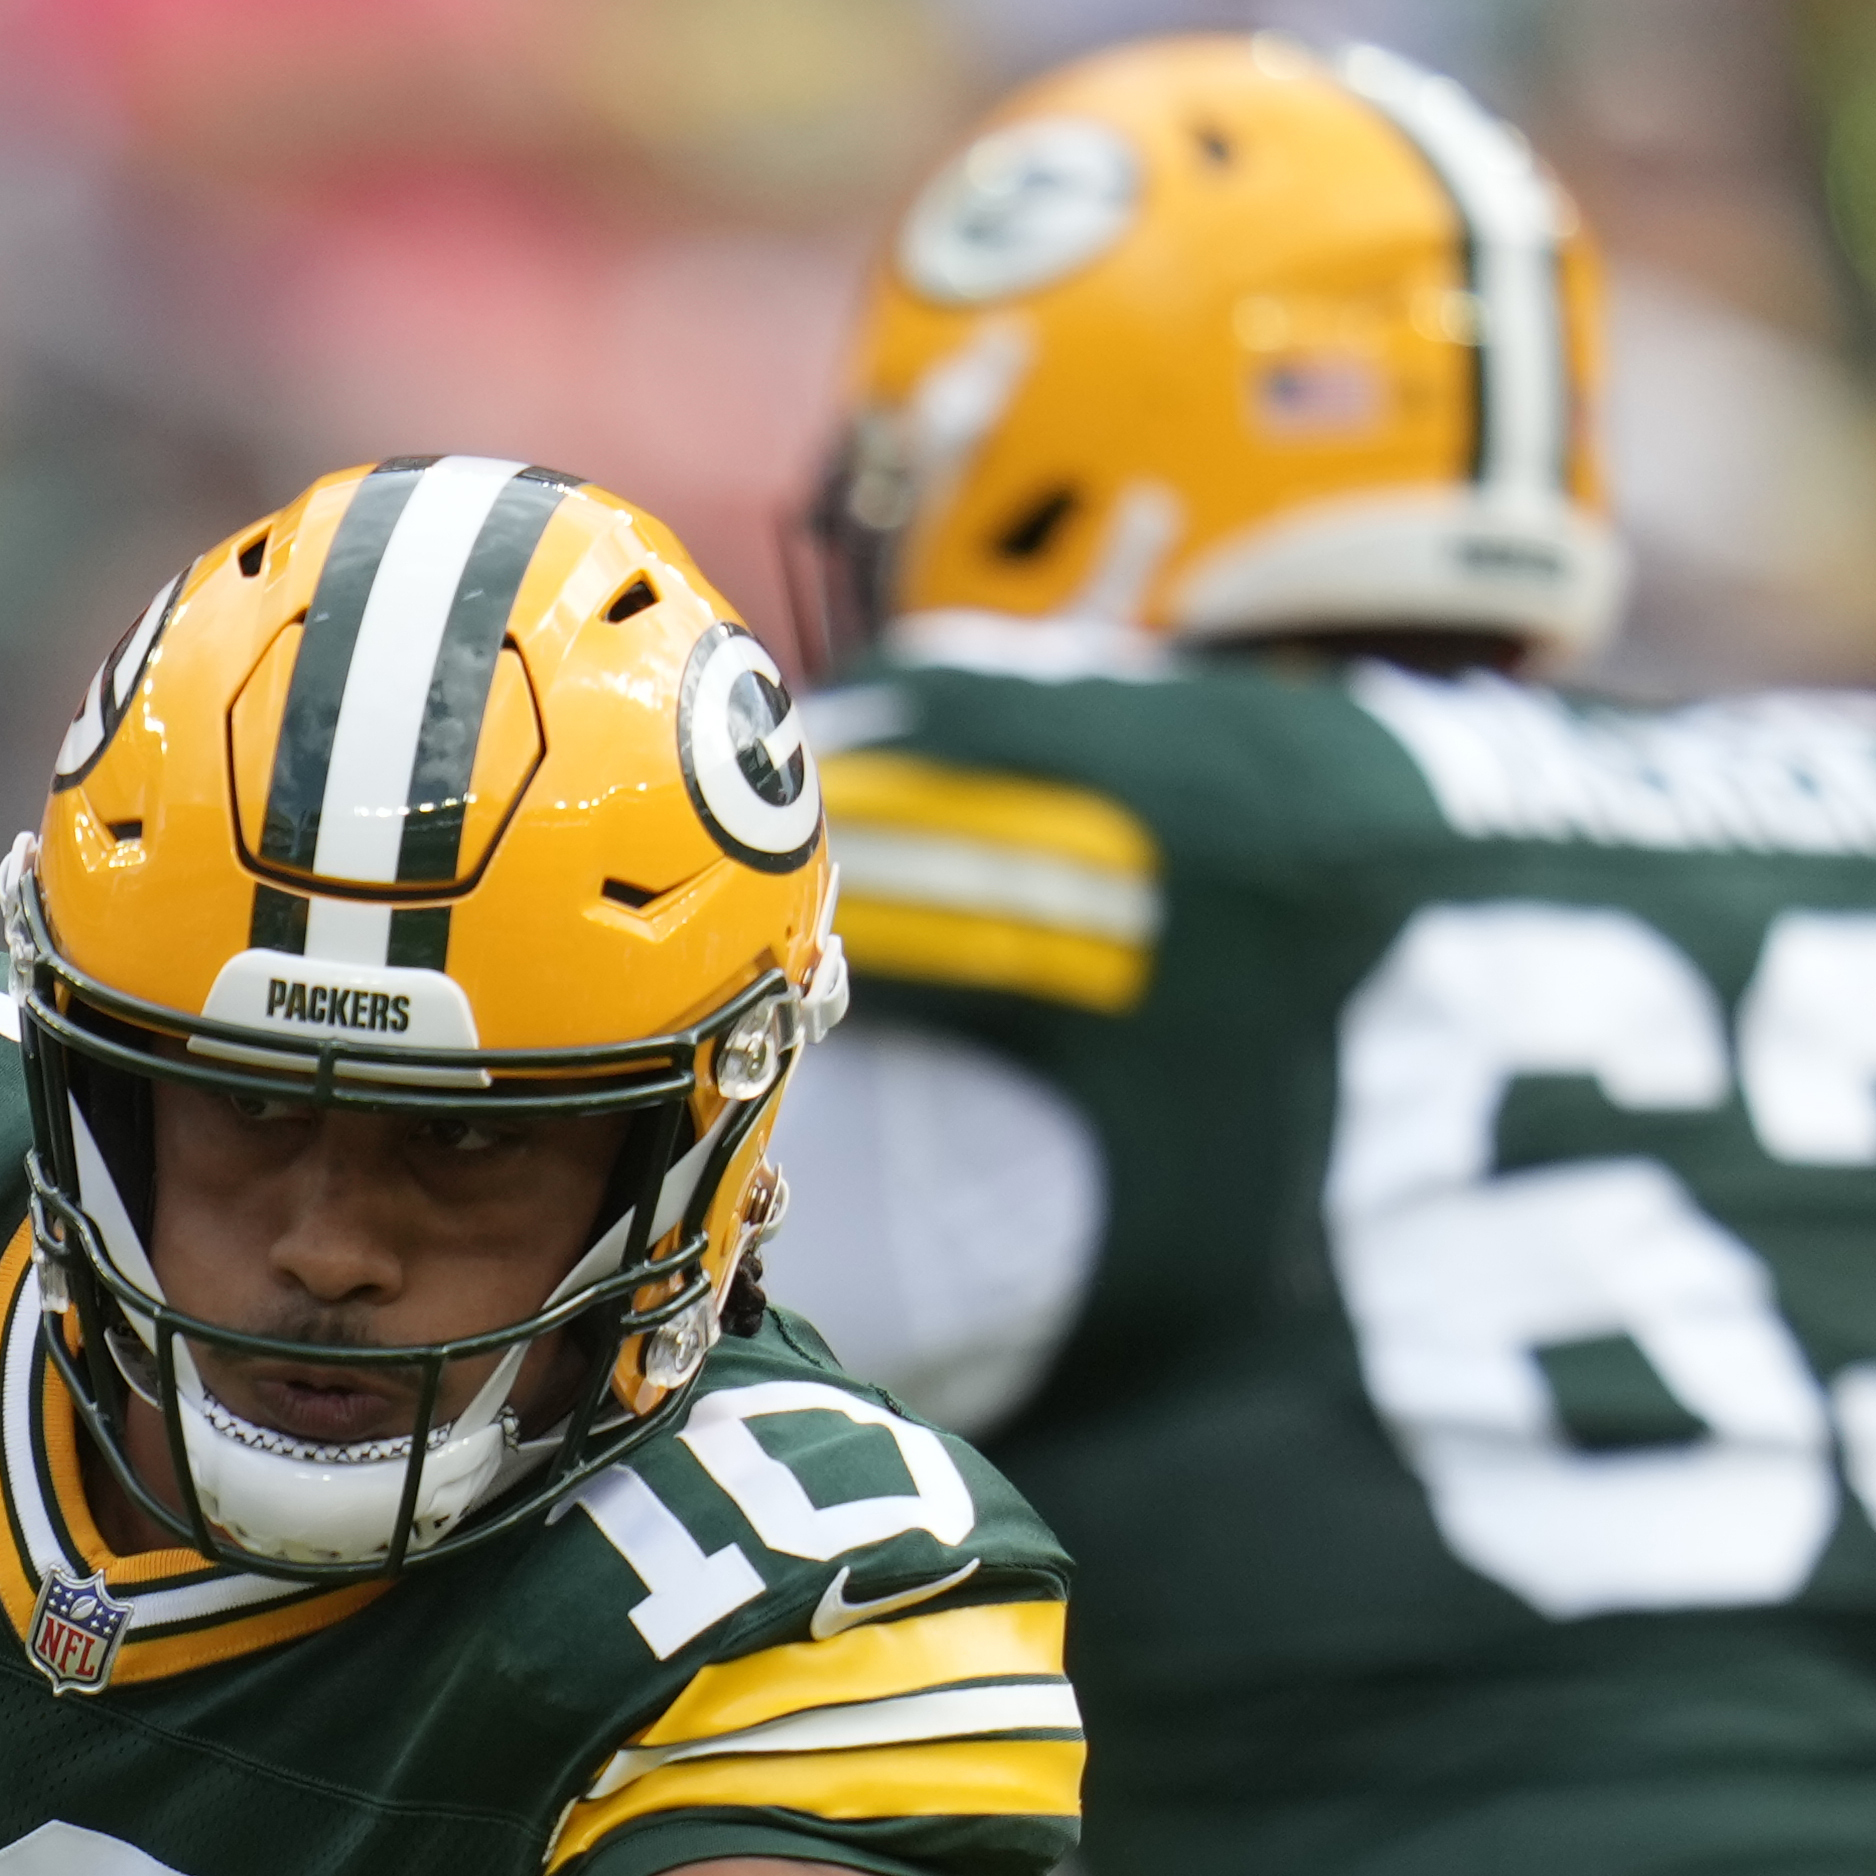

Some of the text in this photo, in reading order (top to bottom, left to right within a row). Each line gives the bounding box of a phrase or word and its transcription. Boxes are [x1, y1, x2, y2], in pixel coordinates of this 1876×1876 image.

[266, 977, 411, 1035] PACKERS
[1322, 898, 1876, 1622] 6
[546, 1378, 976, 1661] 10
[36, 1615, 97, 1679] NFL
